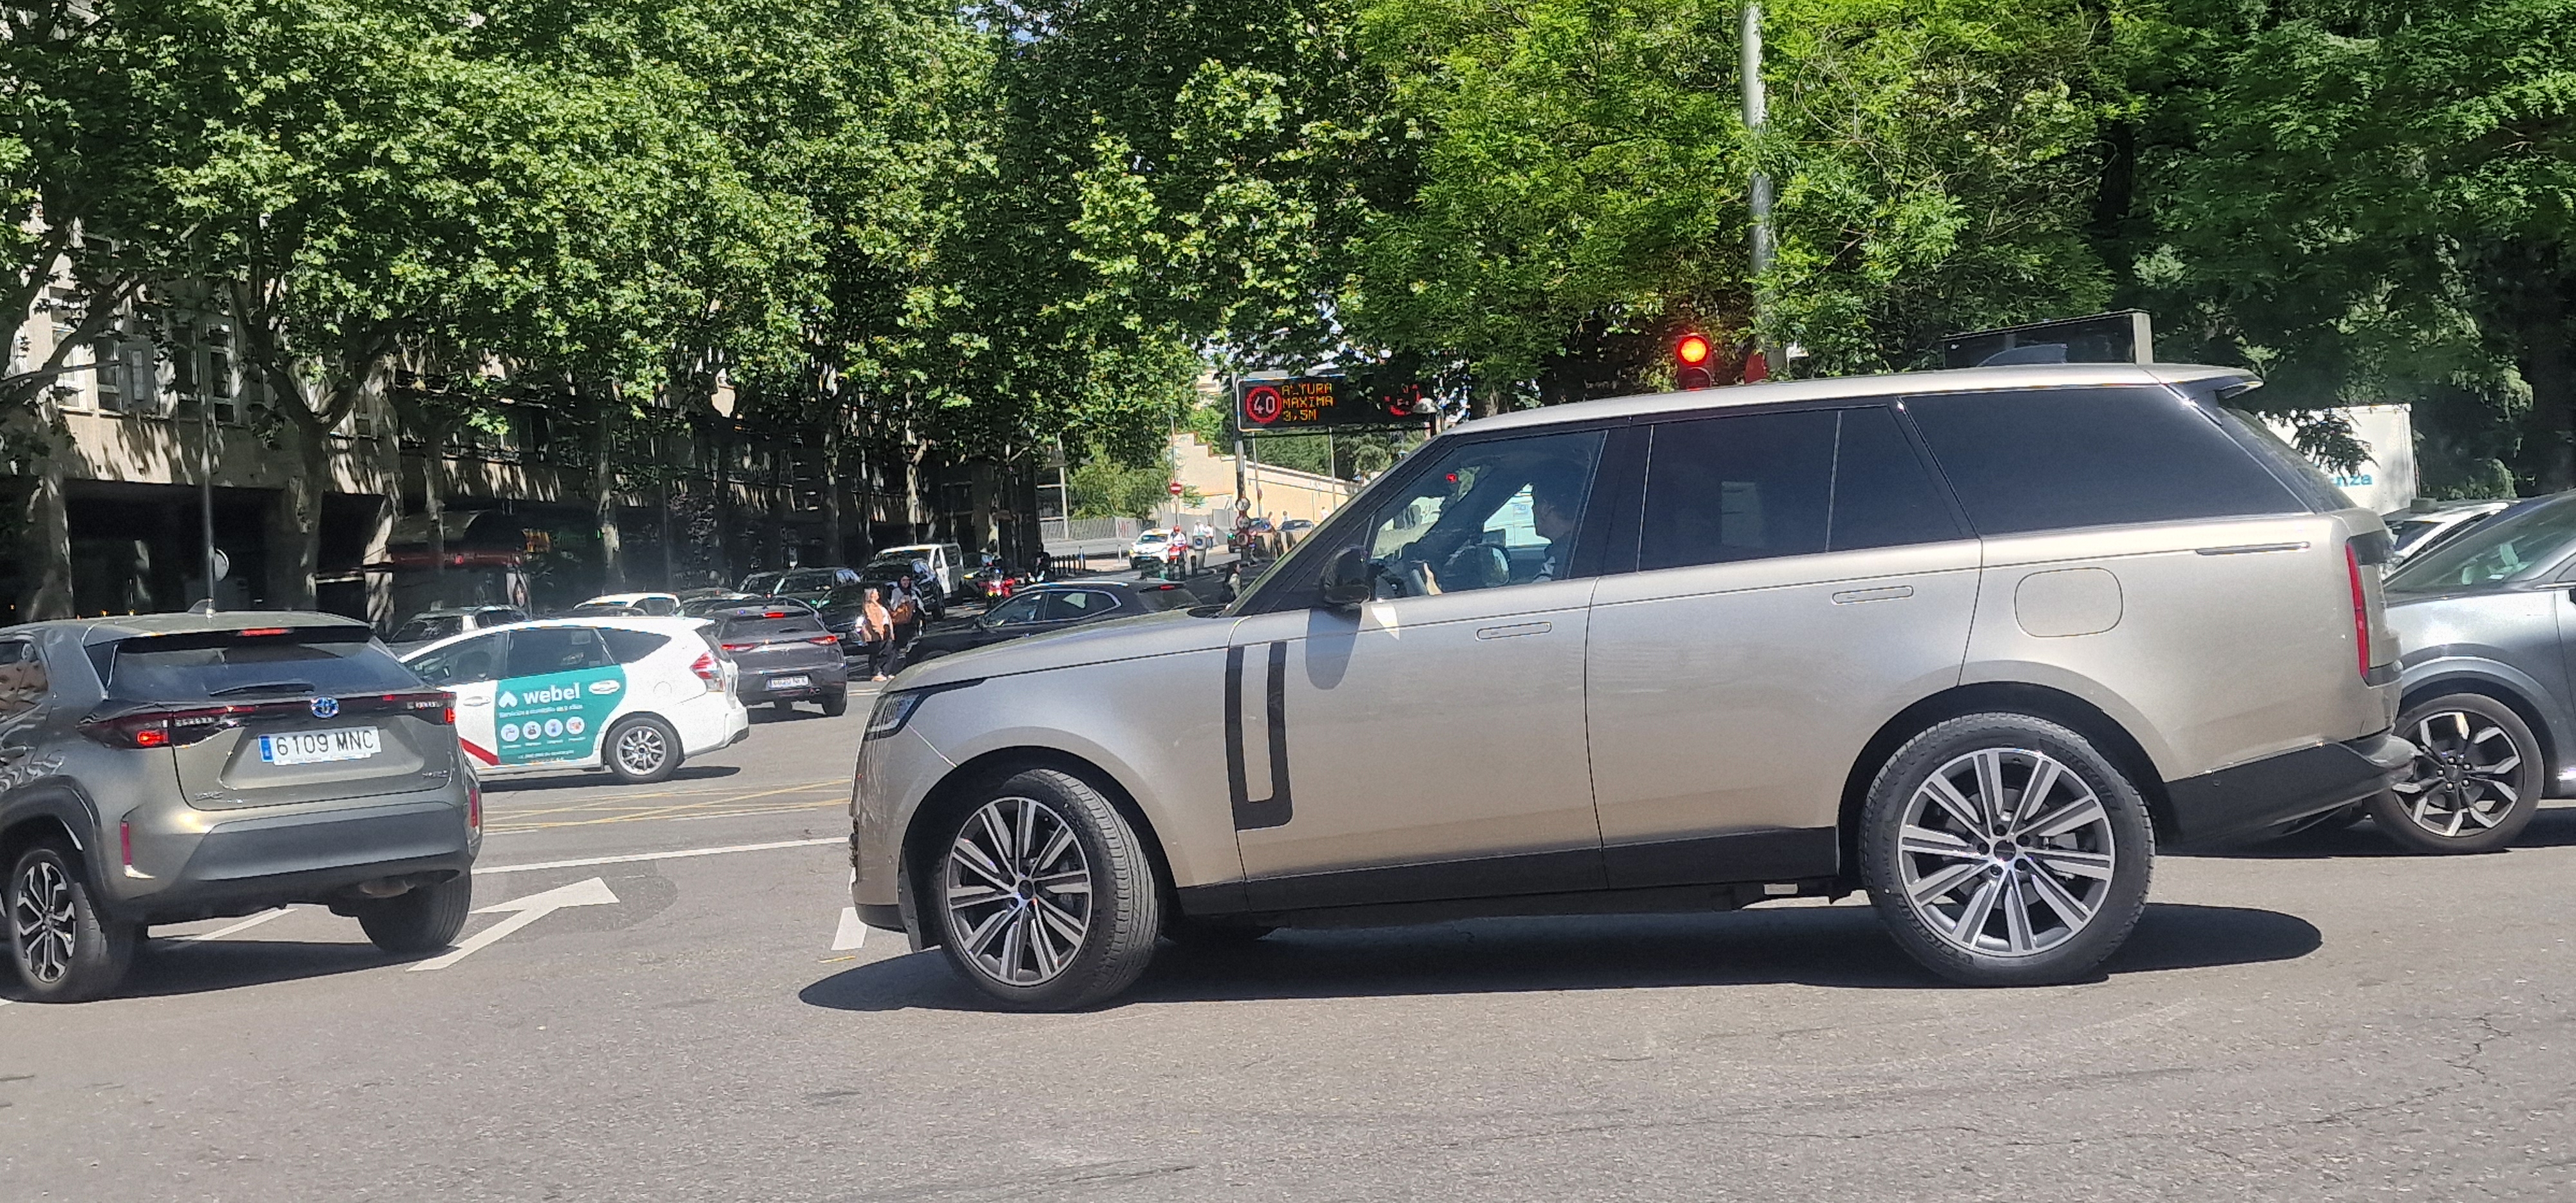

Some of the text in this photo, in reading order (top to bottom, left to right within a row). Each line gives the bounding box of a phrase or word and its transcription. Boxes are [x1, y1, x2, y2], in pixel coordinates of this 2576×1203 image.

[1253, 395, 1276, 414] 40
[523, 682, 580, 705] webel
[276, 730, 374, 756] 6109 MNC
